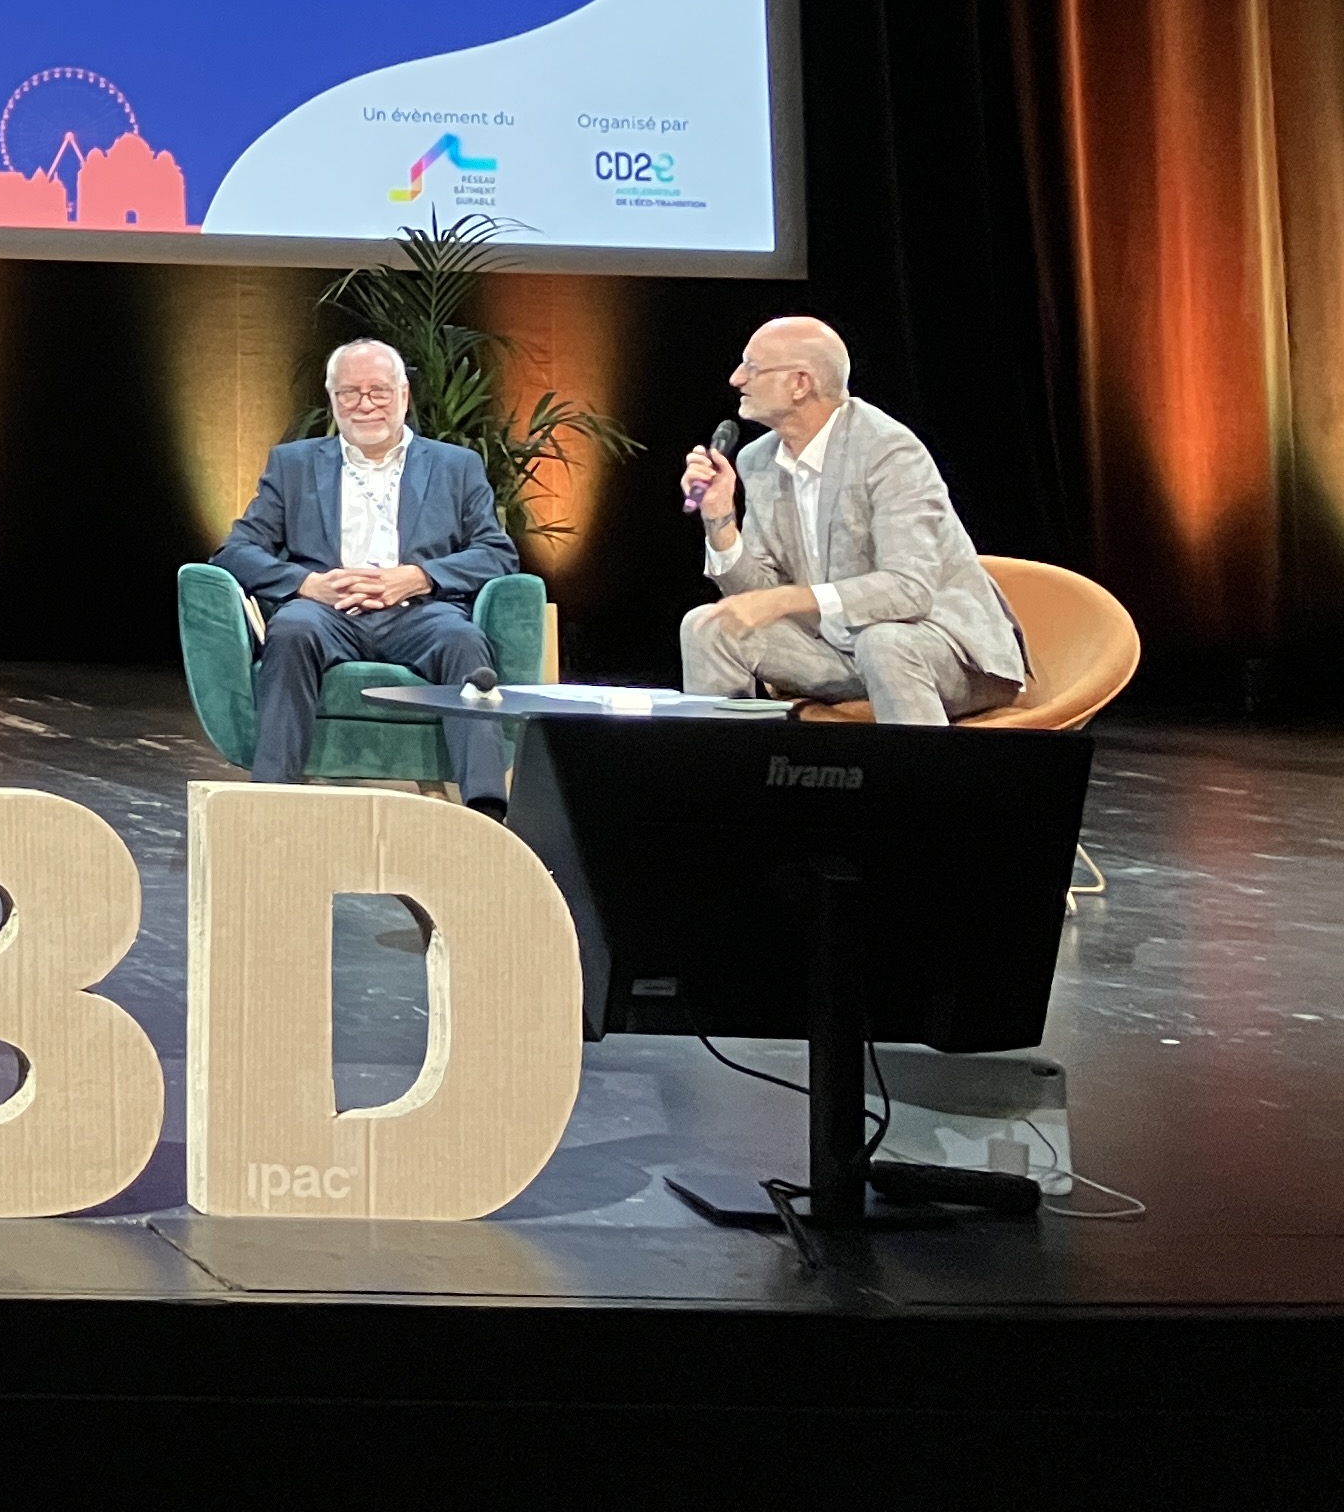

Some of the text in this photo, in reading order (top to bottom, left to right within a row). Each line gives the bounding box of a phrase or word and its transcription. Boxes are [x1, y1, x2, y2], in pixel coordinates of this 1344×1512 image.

[363, 107, 387, 121] Un
[493, 111, 515, 126] du
[577, 113, 689, 134] Organisé par
